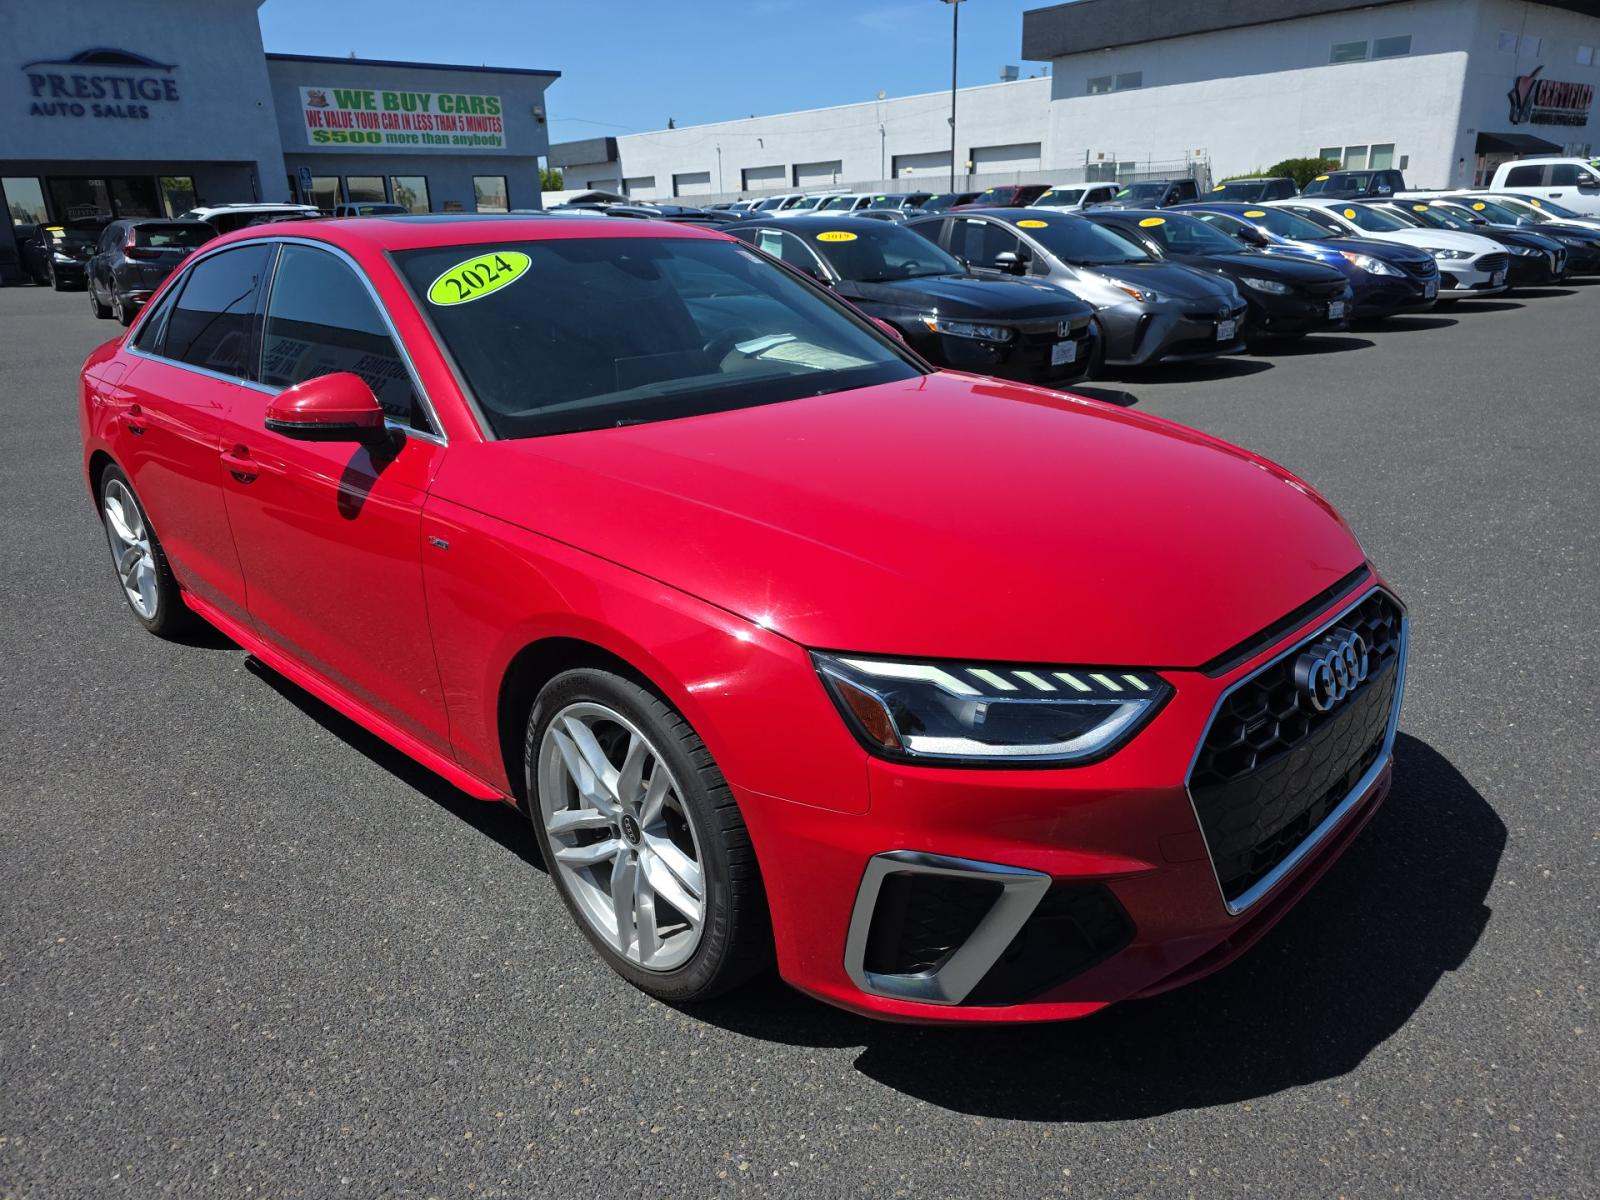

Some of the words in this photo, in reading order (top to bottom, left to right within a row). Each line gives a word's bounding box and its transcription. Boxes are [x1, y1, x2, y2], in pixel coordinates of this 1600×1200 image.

[27, 74, 180, 101] PRESTIGE
[30, 102, 85, 118] AUTO
[93, 104, 149, 120] SALES
[333, 89, 377, 110] WE
[382, 91, 431, 112] BUY
[438, 94, 501, 115] CARS
[306, 110, 324, 128] WE
[324, 111, 354, 129] VALUE
[354, 112, 381, 130] YOUR
[381, 112, 401, 131] CAR
[401, 113, 411, 130] IN
[412, 114, 433, 132] LESS
[433, 114, 457, 132] THAN
[458, 117, 465, 132] 5
[466, 116, 503, 134] MINUTES
[313, 129, 383, 144] $500
[385, 133, 419, 144] more
[421, 132, 451, 145] than
[452, 133, 502, 147] anybody
[446, 255, 513, 299] 2024
